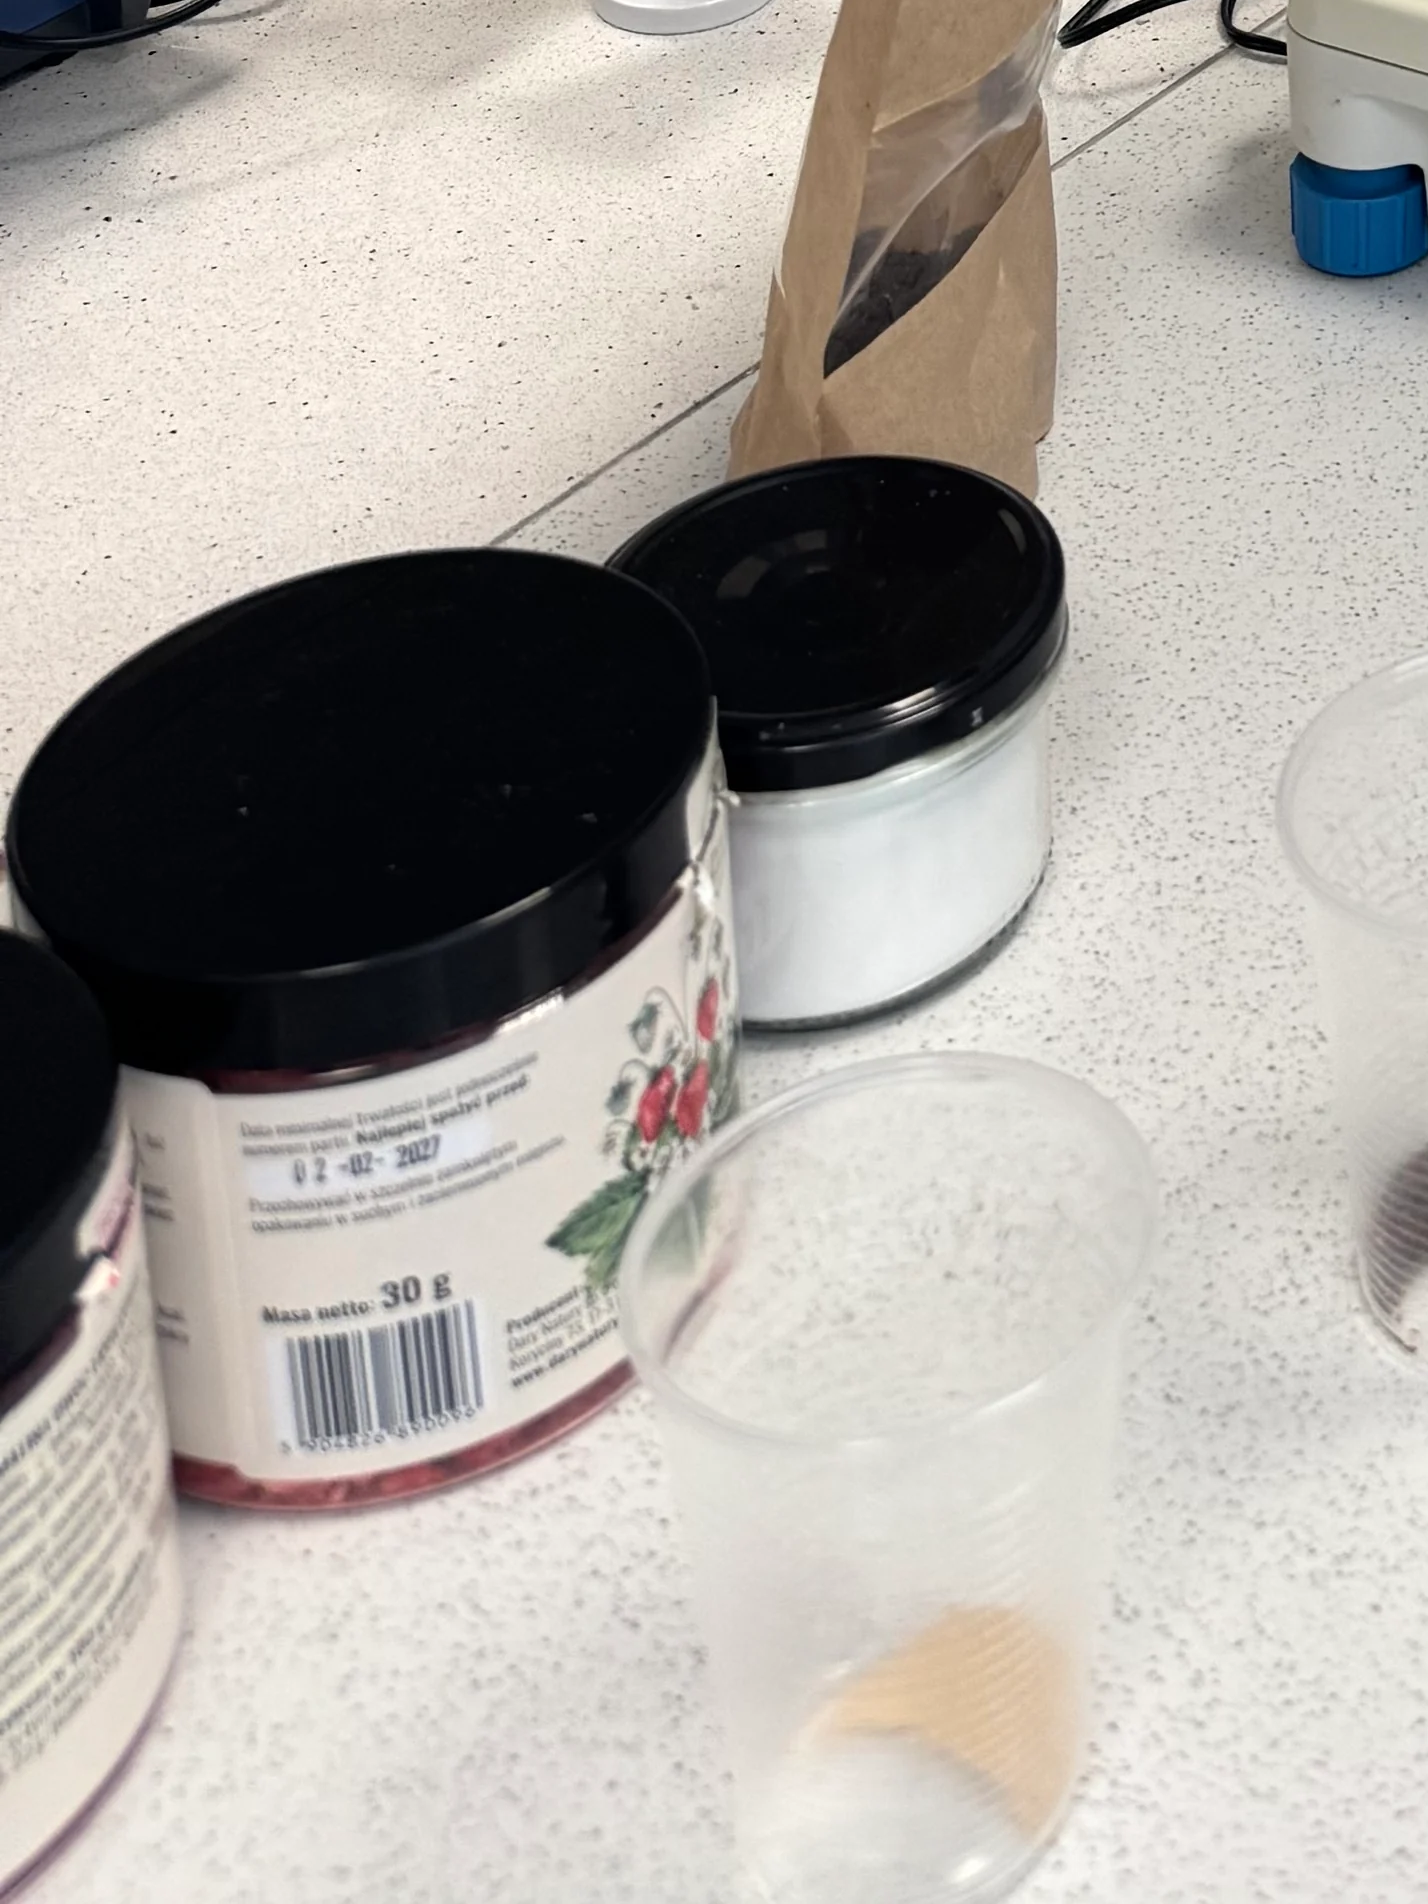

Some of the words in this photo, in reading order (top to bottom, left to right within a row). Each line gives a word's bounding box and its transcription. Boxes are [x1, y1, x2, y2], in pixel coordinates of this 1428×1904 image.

[260, 1303, 313, 1325] Masa
[314, 1297, 377, 1322] netto:
[378, 1273, 423, 1310] 30
[431, 1270, 455, 1301] g
